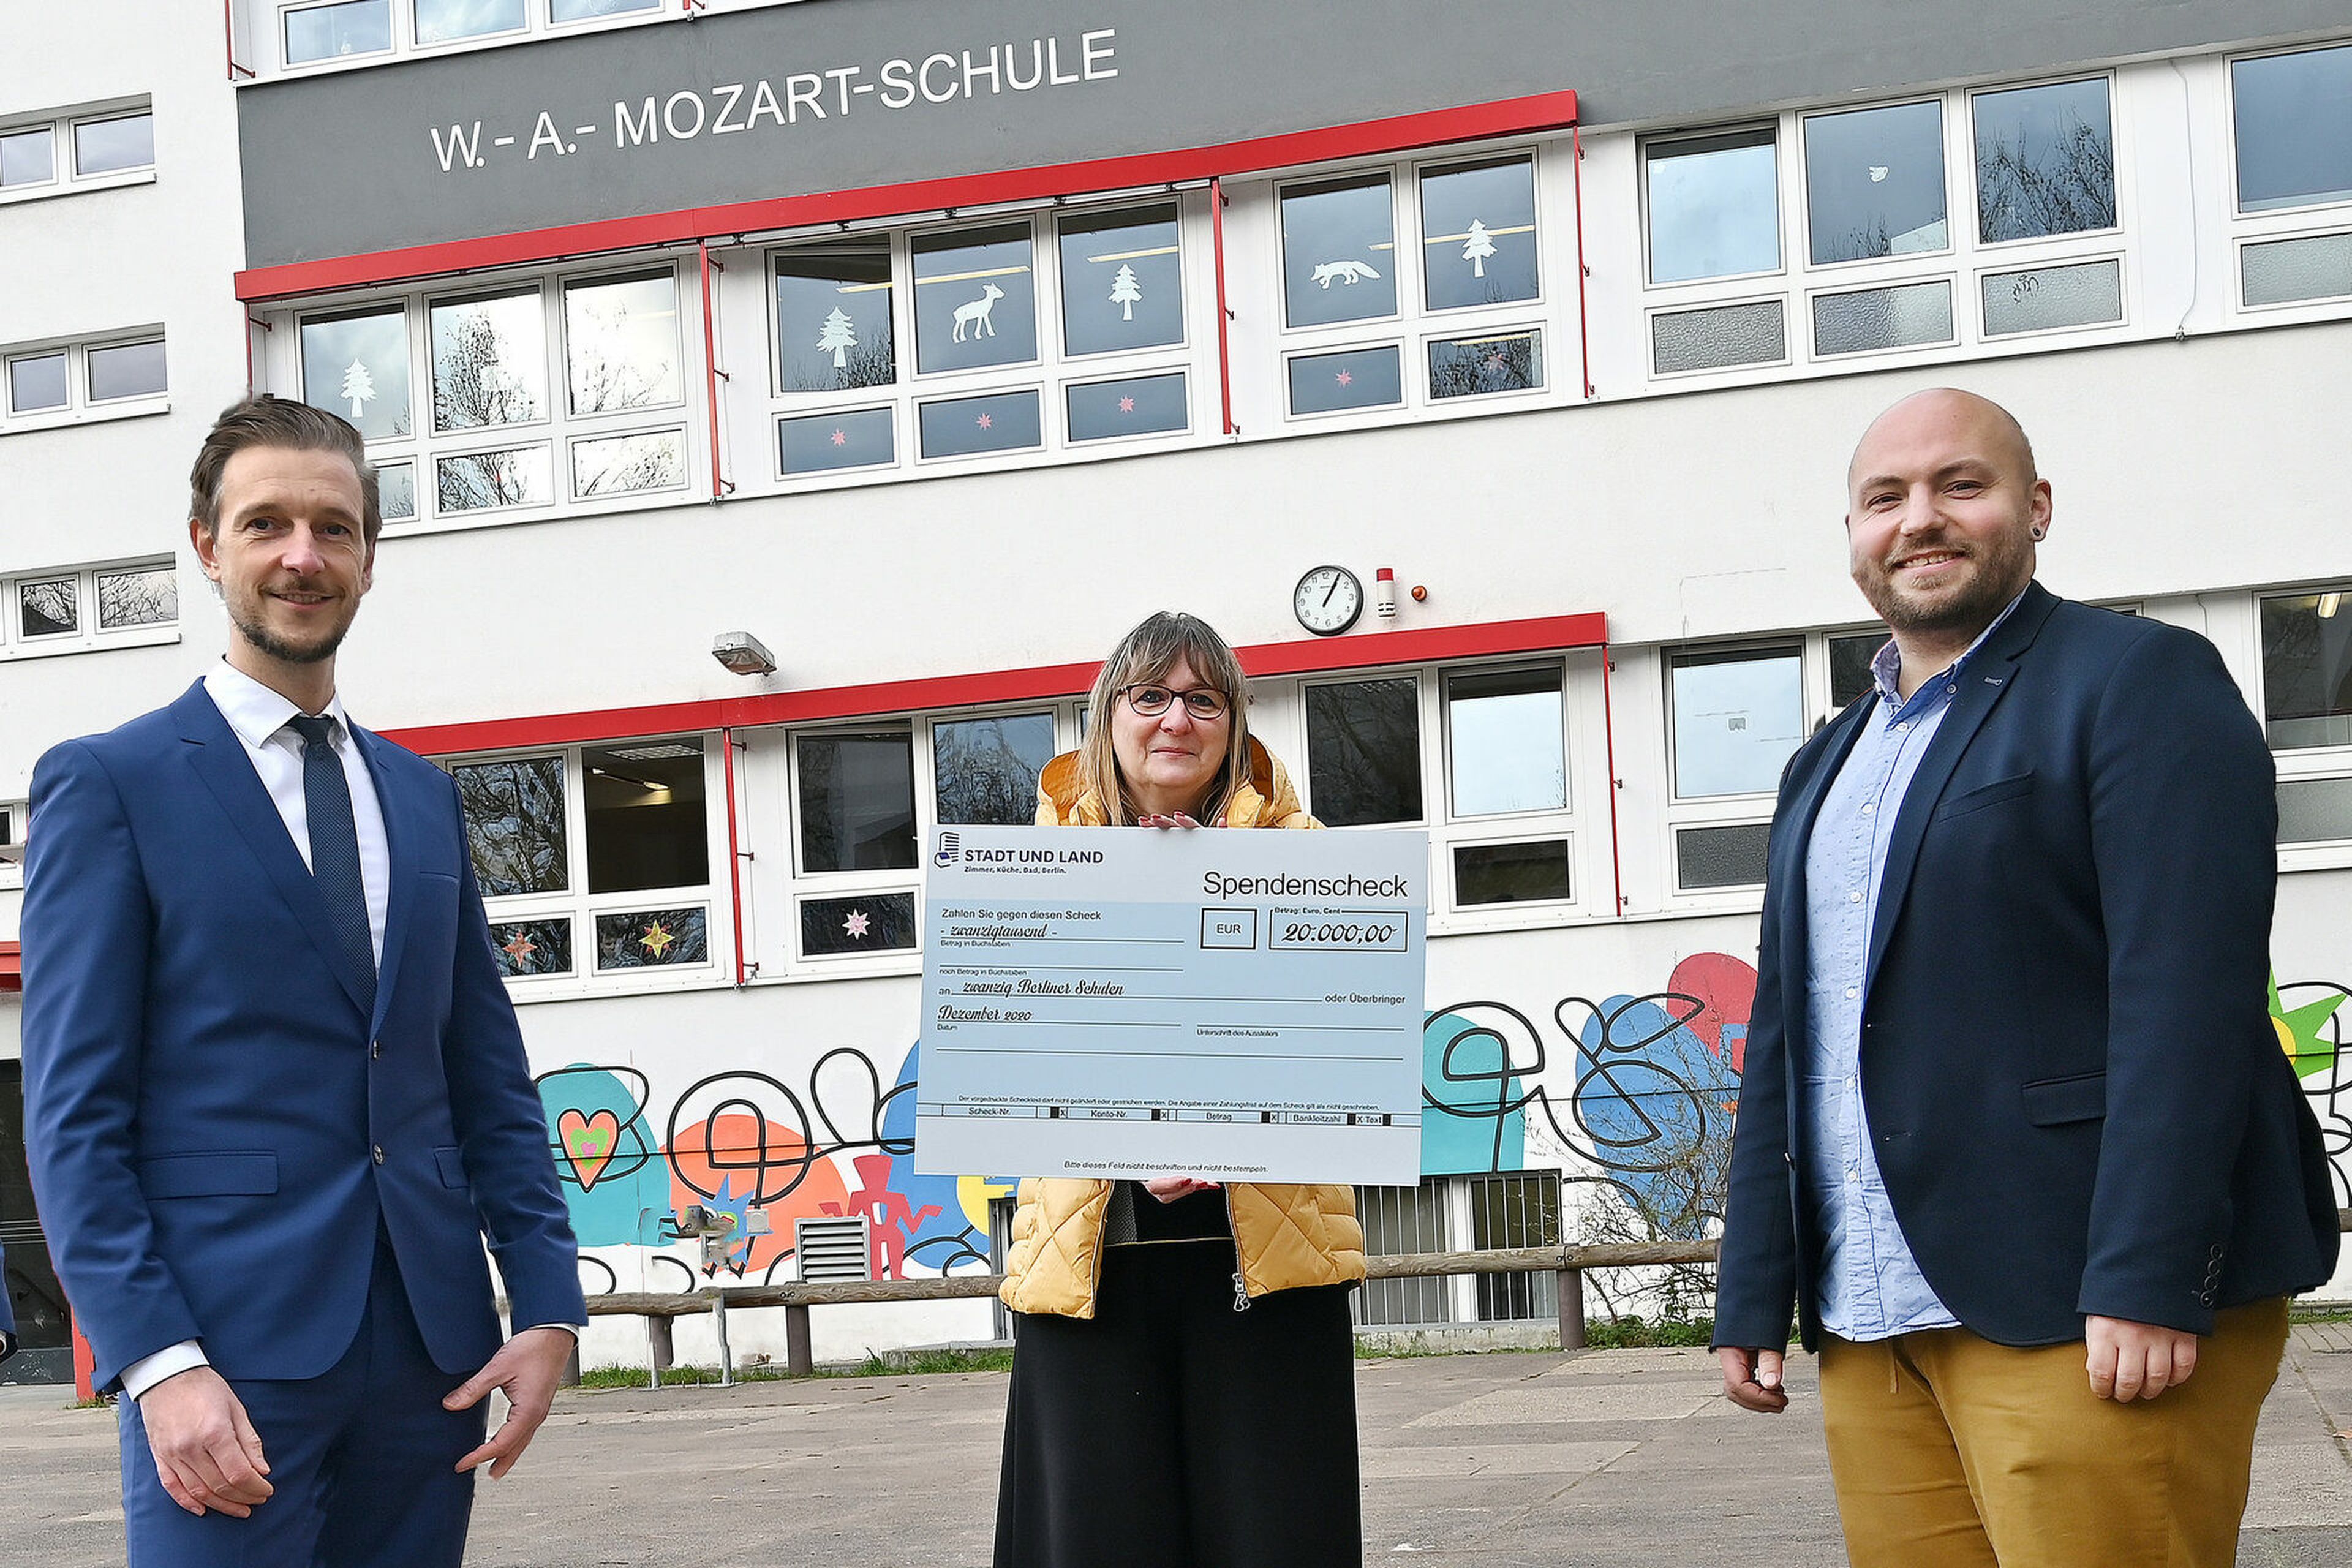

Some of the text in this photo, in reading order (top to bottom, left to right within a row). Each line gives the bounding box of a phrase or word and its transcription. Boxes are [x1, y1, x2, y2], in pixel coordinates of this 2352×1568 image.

[613, 28, 1120, 151] MOZART-SCHULE
[964, 849, 1104, 864] STADT UND LAND
[1203, 871, 1408, 900] Spendenscheck
[941, 909, 1102, 921] Zahlen Sie gegen diesen Scheck
[950, 924, 1049, 944] zwanzigtausend
[1216, 924, 1242, 934] EUR
[1281, 923, 1398, 945] 20.000,00
[962, 981, 1013, 998] zwanzig
[1016, 979, 1071, 995] Berliner
[1074, 979, 1125, 996] Schulen
[1324, 992, 1406, 1005] oder Überbringer
[938, 1005, 1033, 1022] Dezember 2020
[1206, 1112, 1232, 1122] Betrag
[1292, 1114, 1341, 1123] Bankleitzahl
[1365, 1116, 1382, 1125] Text
